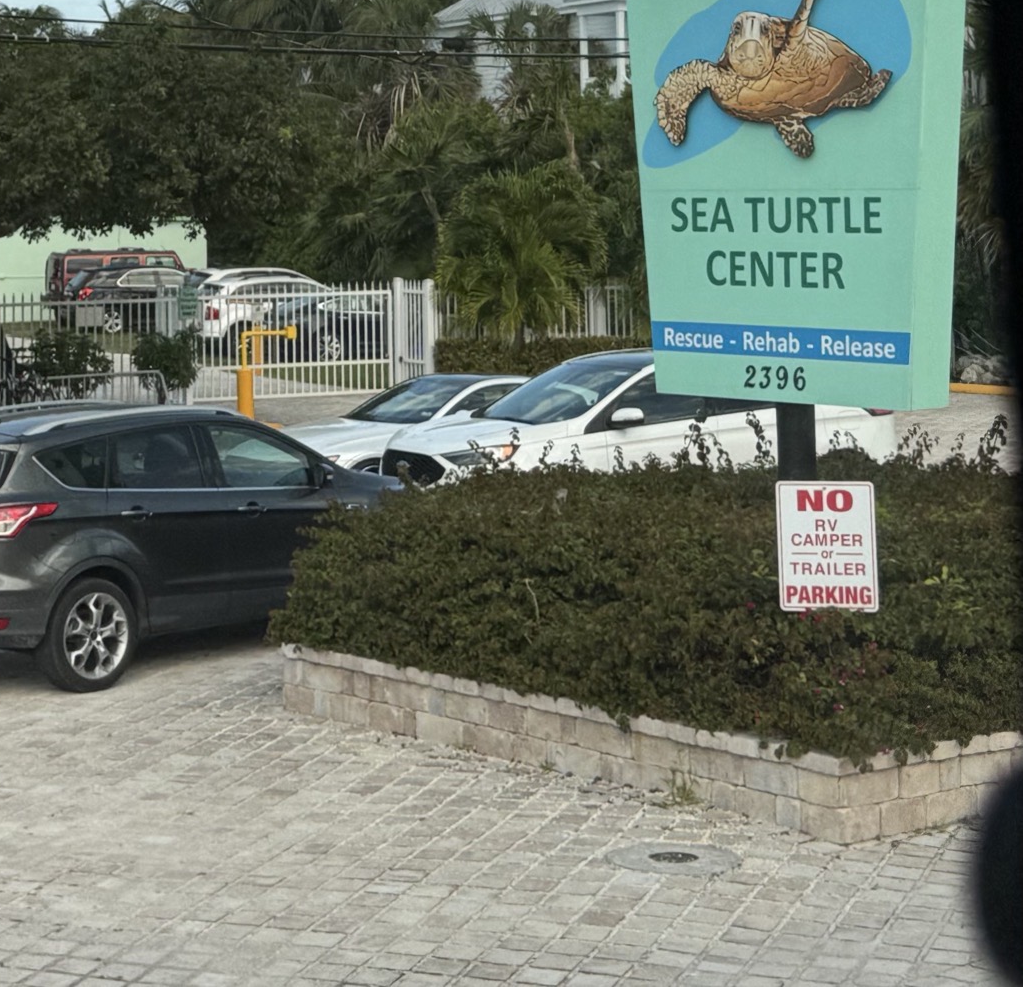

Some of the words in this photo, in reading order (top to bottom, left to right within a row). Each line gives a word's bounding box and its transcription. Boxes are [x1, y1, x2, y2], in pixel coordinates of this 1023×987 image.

[670, 196, 735, 233] SEA
[743, 196, 883, 234] TURTLE
[705, 249, 846, 290] CENTER
[663, 327, 724, 349] Rescue
[742, 331, 801, 354] Rehab
[820, 334, 896, 359] Release
[743, 364, 807, 392] 2396
[796, 489, 854, 512] NO
[815, 518, 838, 532] RV
[791, 533, 863, 547] CAMPER
[821, 550, 834, 559] or
[789, 562, 867, 576] TRAILER
[786, 585, 873, 605] PARKING
